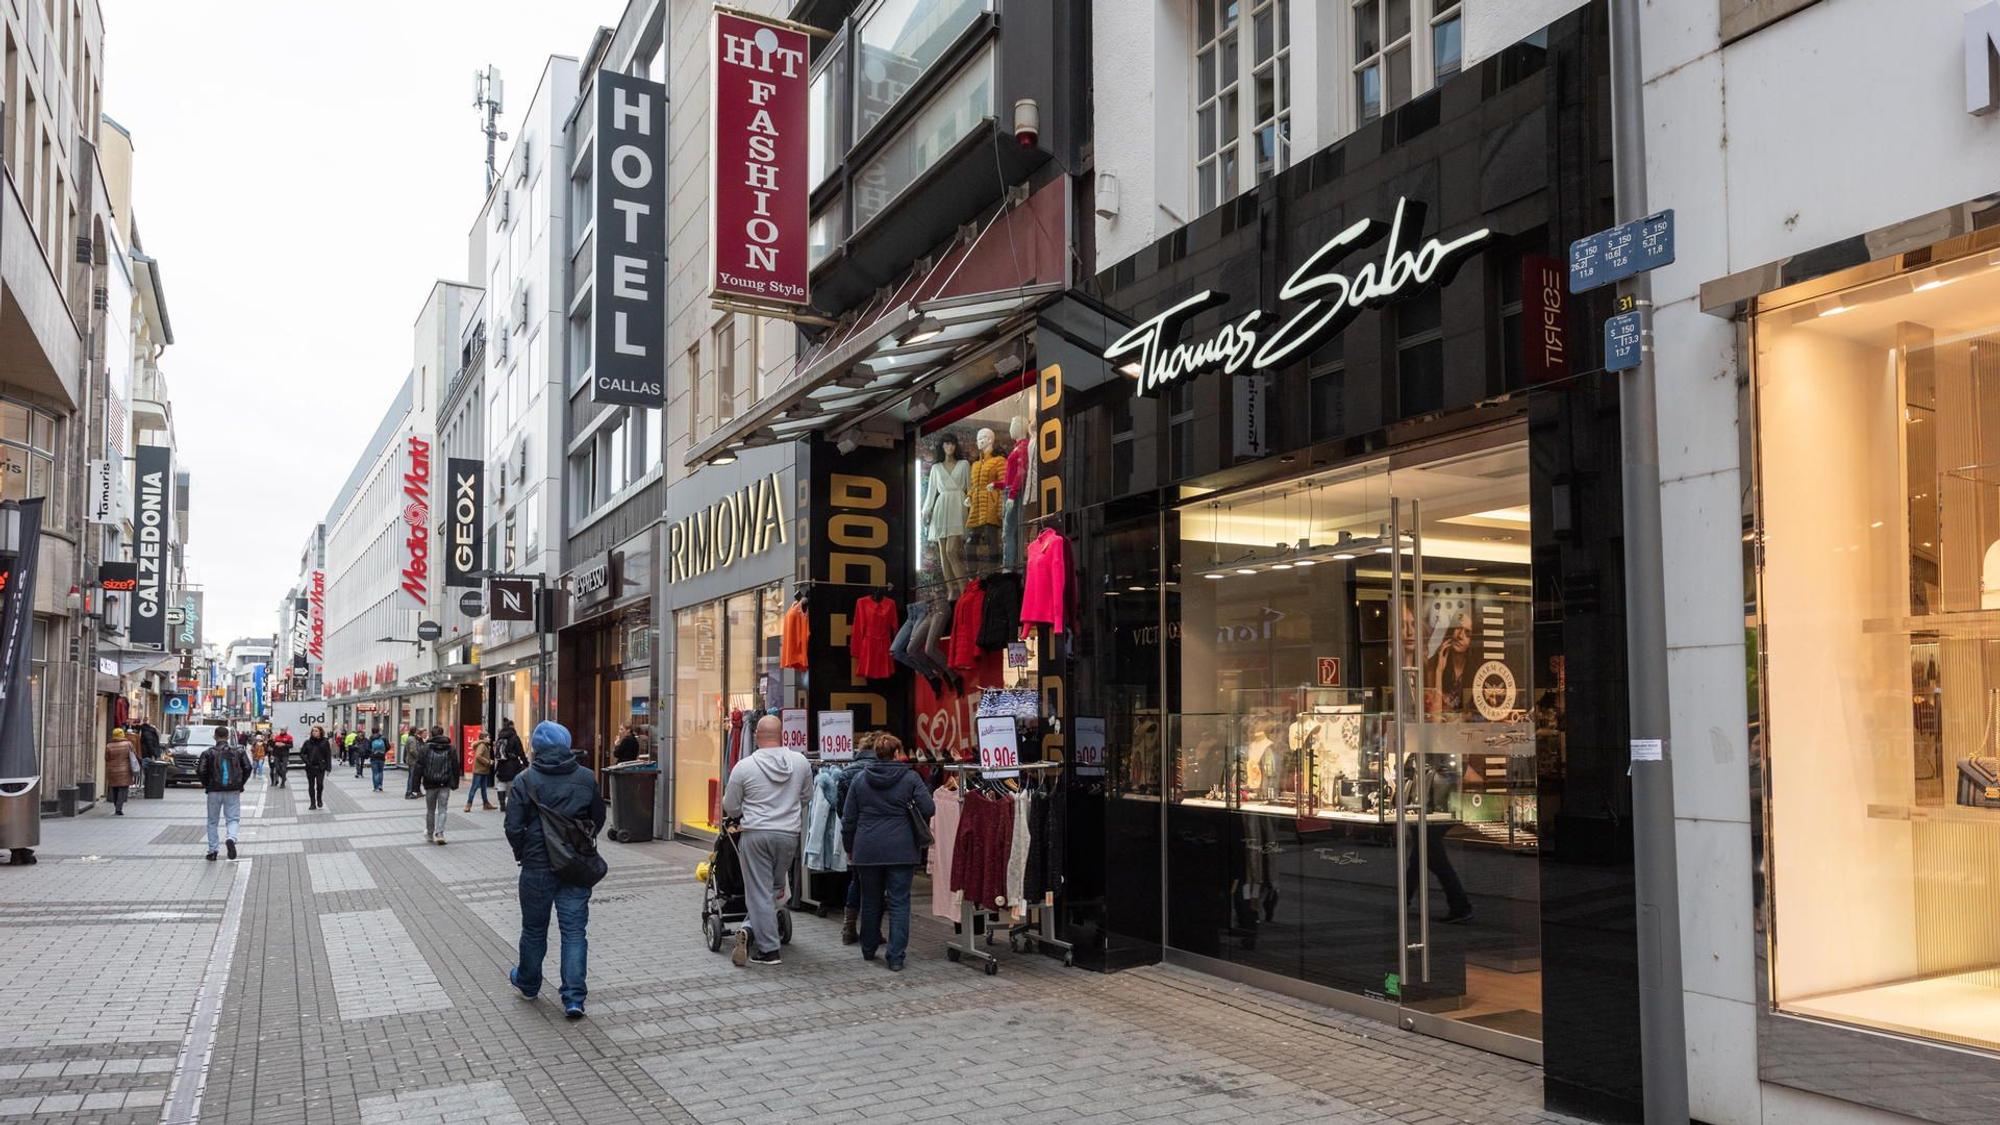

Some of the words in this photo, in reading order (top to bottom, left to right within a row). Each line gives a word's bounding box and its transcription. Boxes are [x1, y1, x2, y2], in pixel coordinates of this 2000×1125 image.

[723, 28, 803, 78] HIT
[745, 79, 779, 272] FASHION
[611, 87, 652, 357] HOTEL
[1653, 221, 1668, 233] 150
[1618, 234, 1632, 244] 150
[719, 272, 766, 293] Young
[769, 279, 805, 297] Style
[1104, 290, 1262, 397] Thomas
[1253, 196, 1490, 370] Sabo
[1620, 296, 1633, 311] 31
[1610, 329, 1616, 338] S
[1621, 324, 1635, 334] 150
[599, 376, 661, 396] CALLAS
[455, 473, 475, 572] GEOX
[668, 471, 787, 584] RIMOWA
[138, 471, 162, 618] CALZEDONIA
[103, 579, 135, 590] size?
[497, 588, 526, 613] N
[300, 712, 325, 727] dpd
